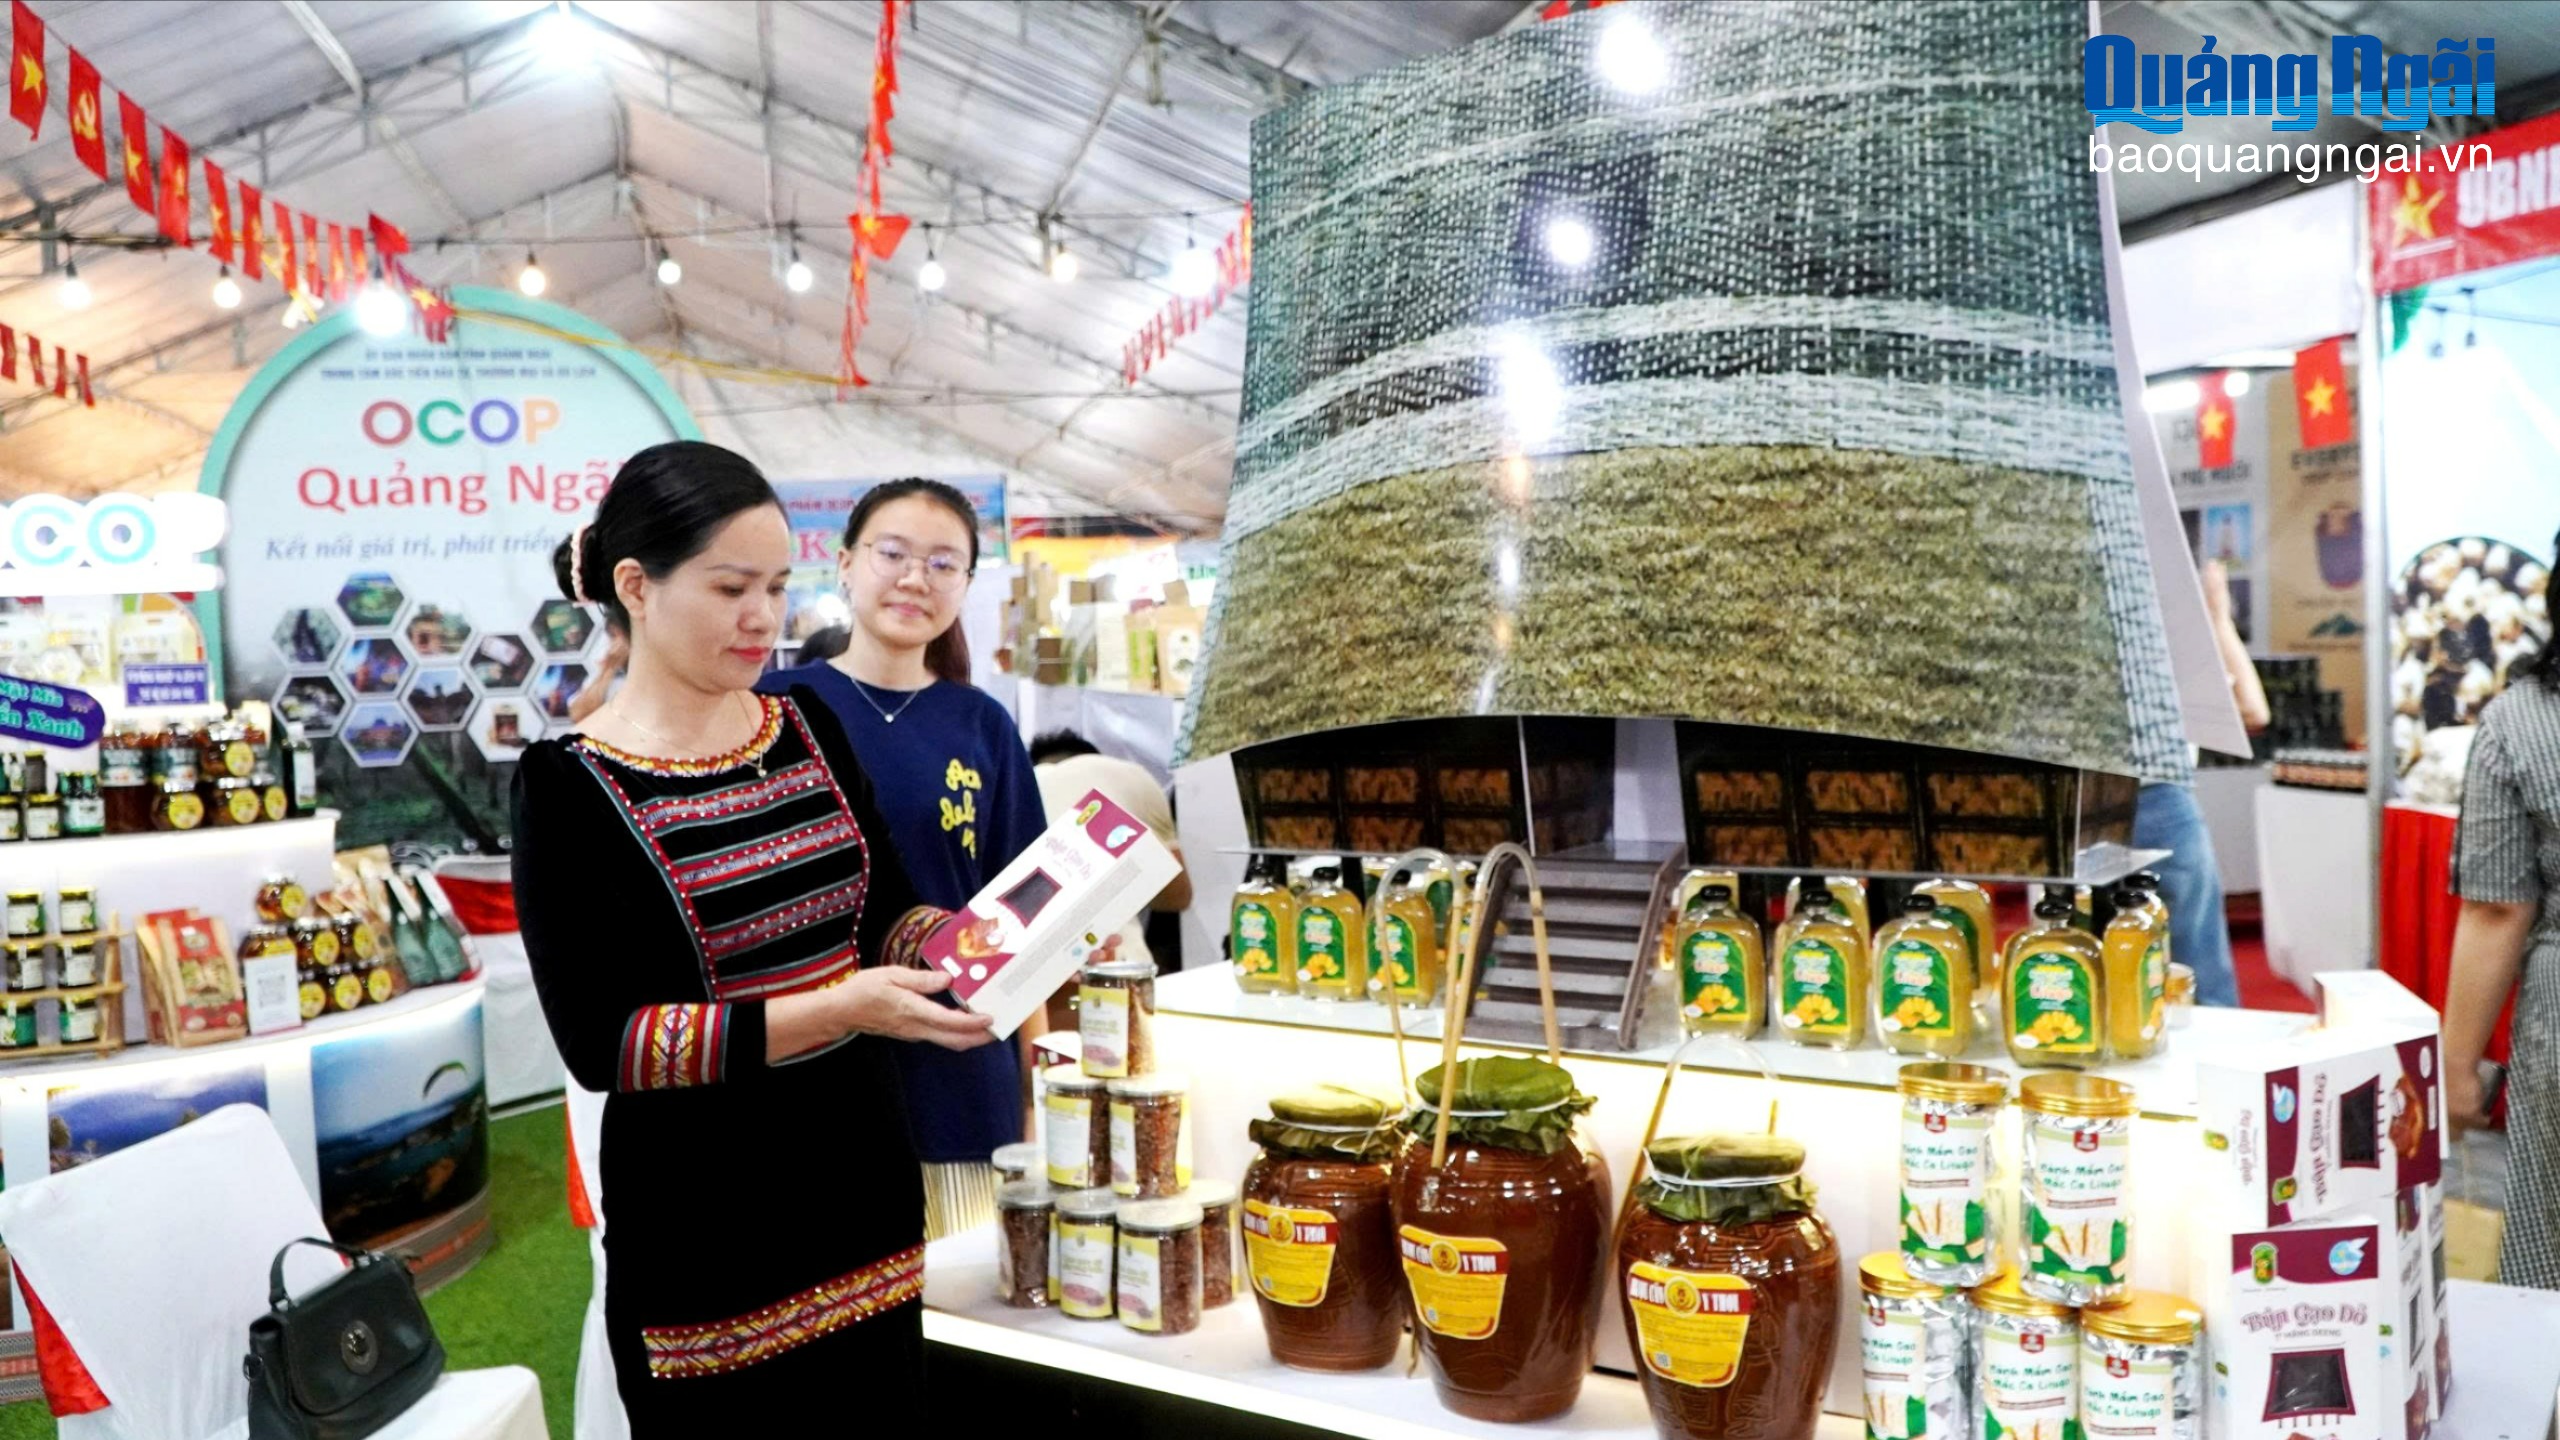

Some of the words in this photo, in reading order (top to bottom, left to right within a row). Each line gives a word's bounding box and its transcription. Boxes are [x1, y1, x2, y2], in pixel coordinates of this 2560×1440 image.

[361, 399, 563, 447] OCOP
[297, 459, 488, 515] Quảng
[508, 460, 629, 513] Ngã
[315, 534, 353, 560] nối
[359, 533, 395, 564] giá
[443, 530, 496, 560] phát
[795, 531, 830, 561] K
[25, 707, 85, 741] Xanh
